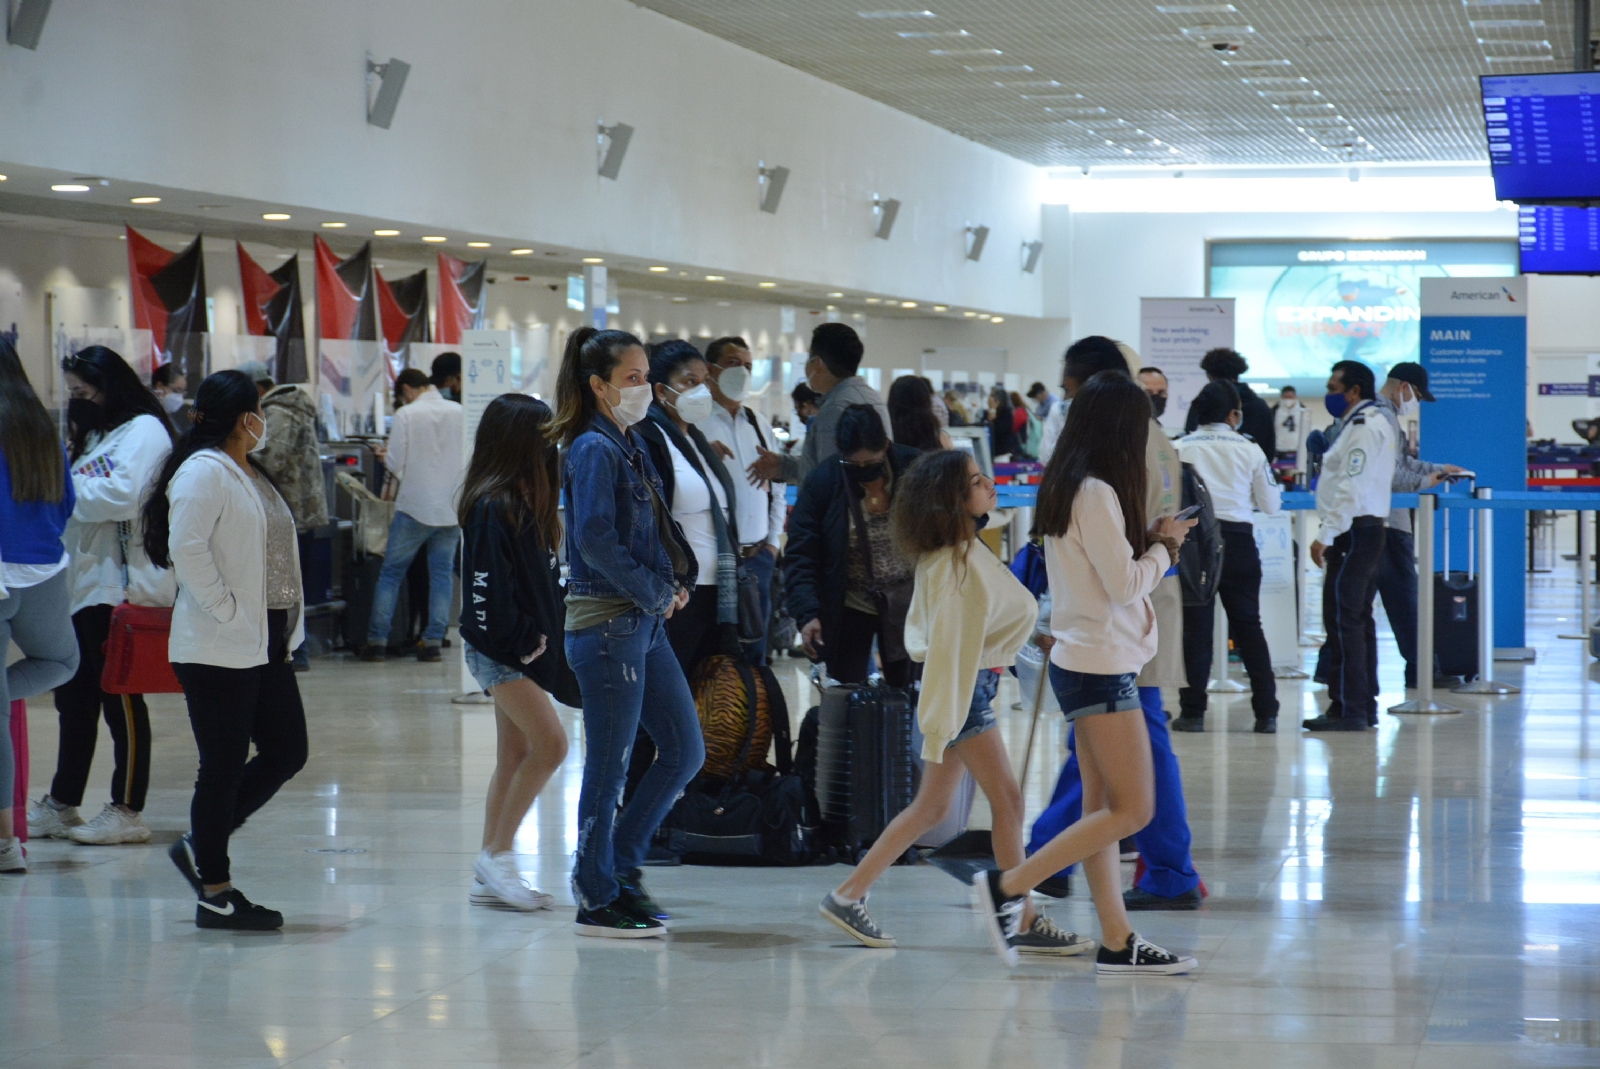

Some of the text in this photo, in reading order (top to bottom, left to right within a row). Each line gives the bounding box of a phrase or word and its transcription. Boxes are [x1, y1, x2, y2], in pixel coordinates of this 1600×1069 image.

[1297, 250, 1346, 262] GRUPO
[1450, 290, 1501, 301] American
[1276, 321, 1386, 338] IMPACT
[1429, 329, 1472, 341] MAIN
[1429, 347, 1504, 356] Customer Assistance
[1282, 415, 1296, 432] 4
